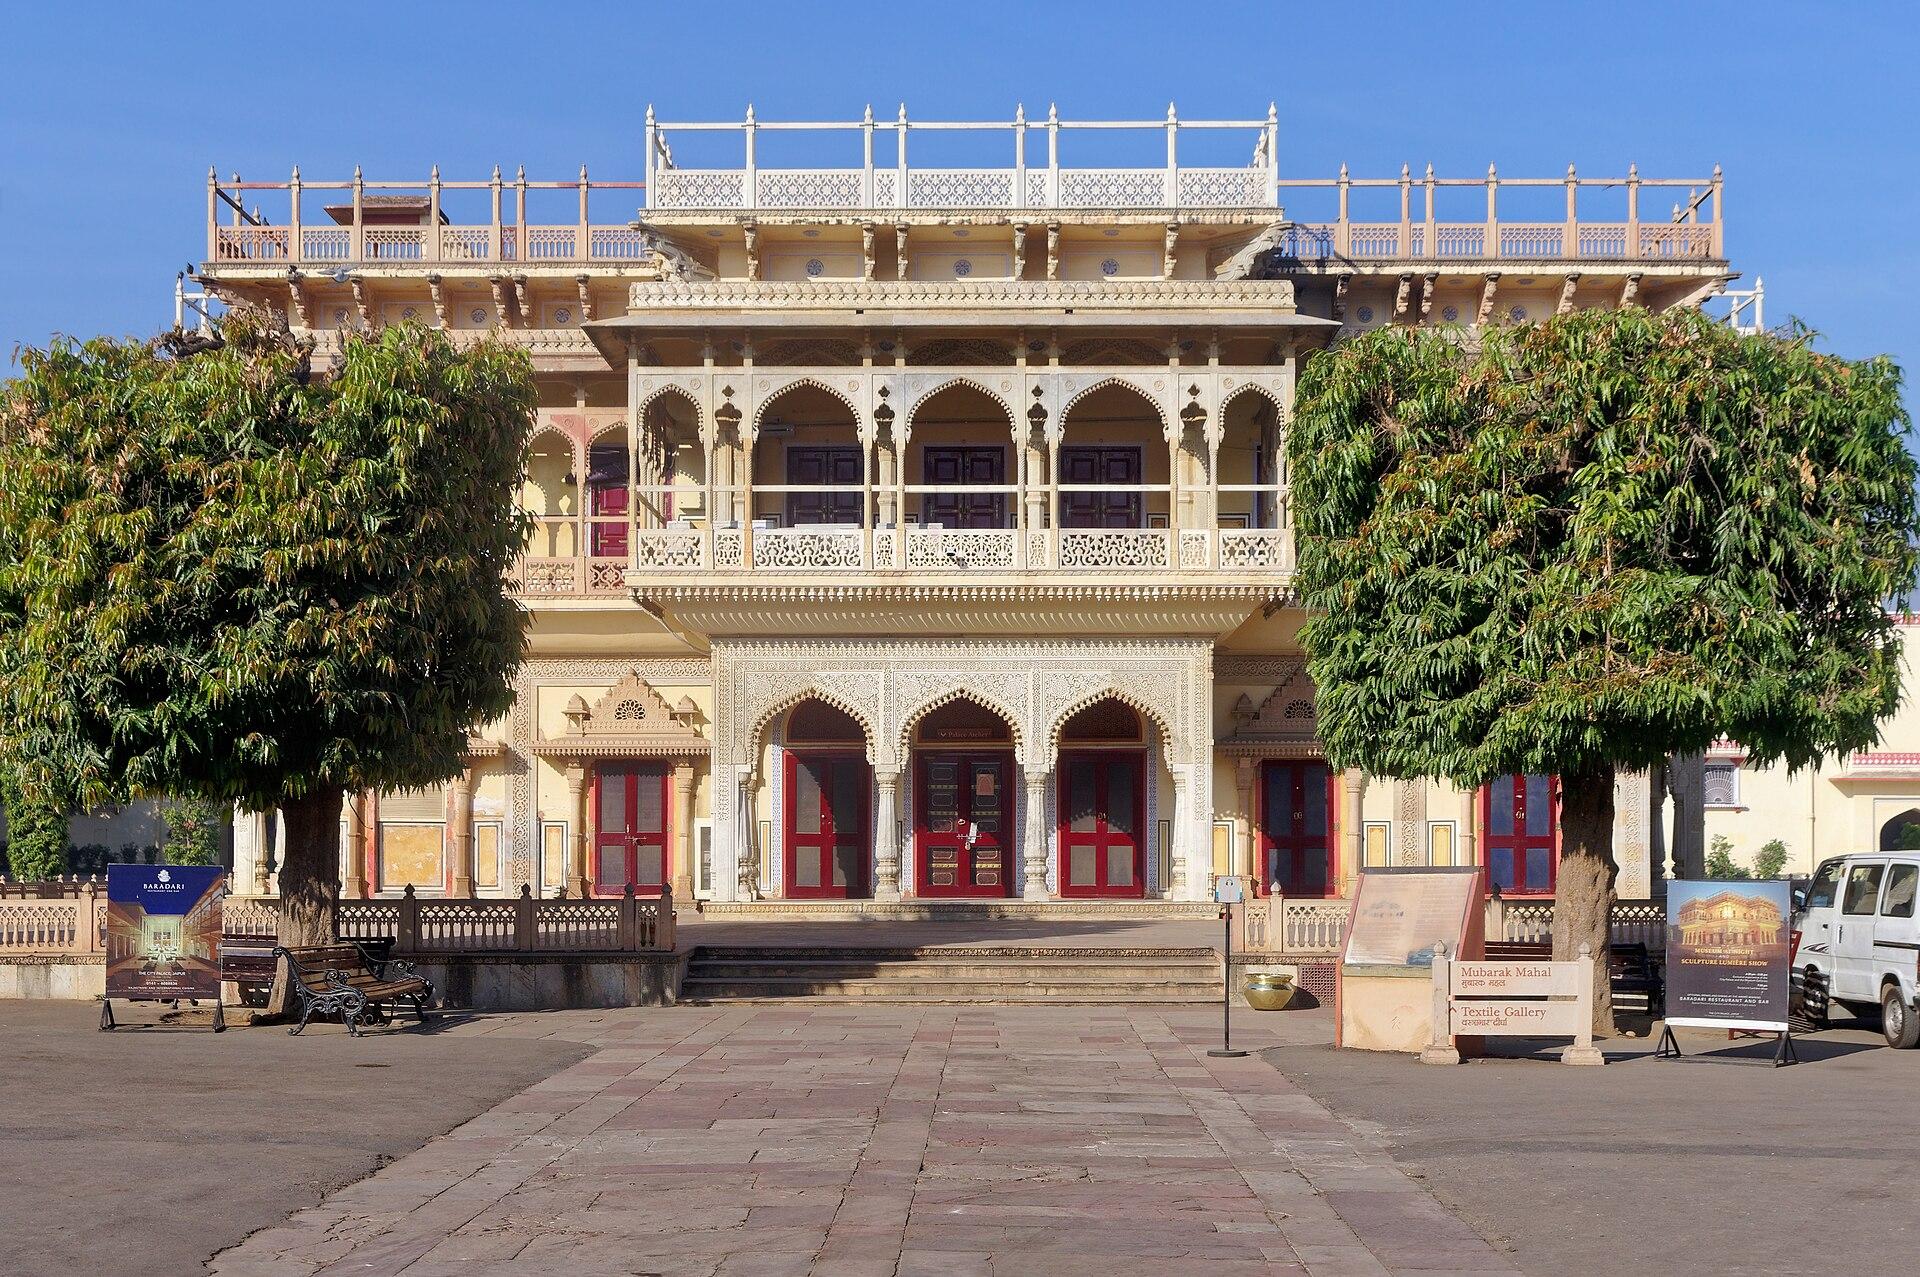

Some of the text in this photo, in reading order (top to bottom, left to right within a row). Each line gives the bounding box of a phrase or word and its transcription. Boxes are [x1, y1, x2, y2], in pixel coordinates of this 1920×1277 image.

[1461, 967, 1552, 977] Mubarak Mahal
[1461, 1006, 1547, 1020] Textile Gallery
